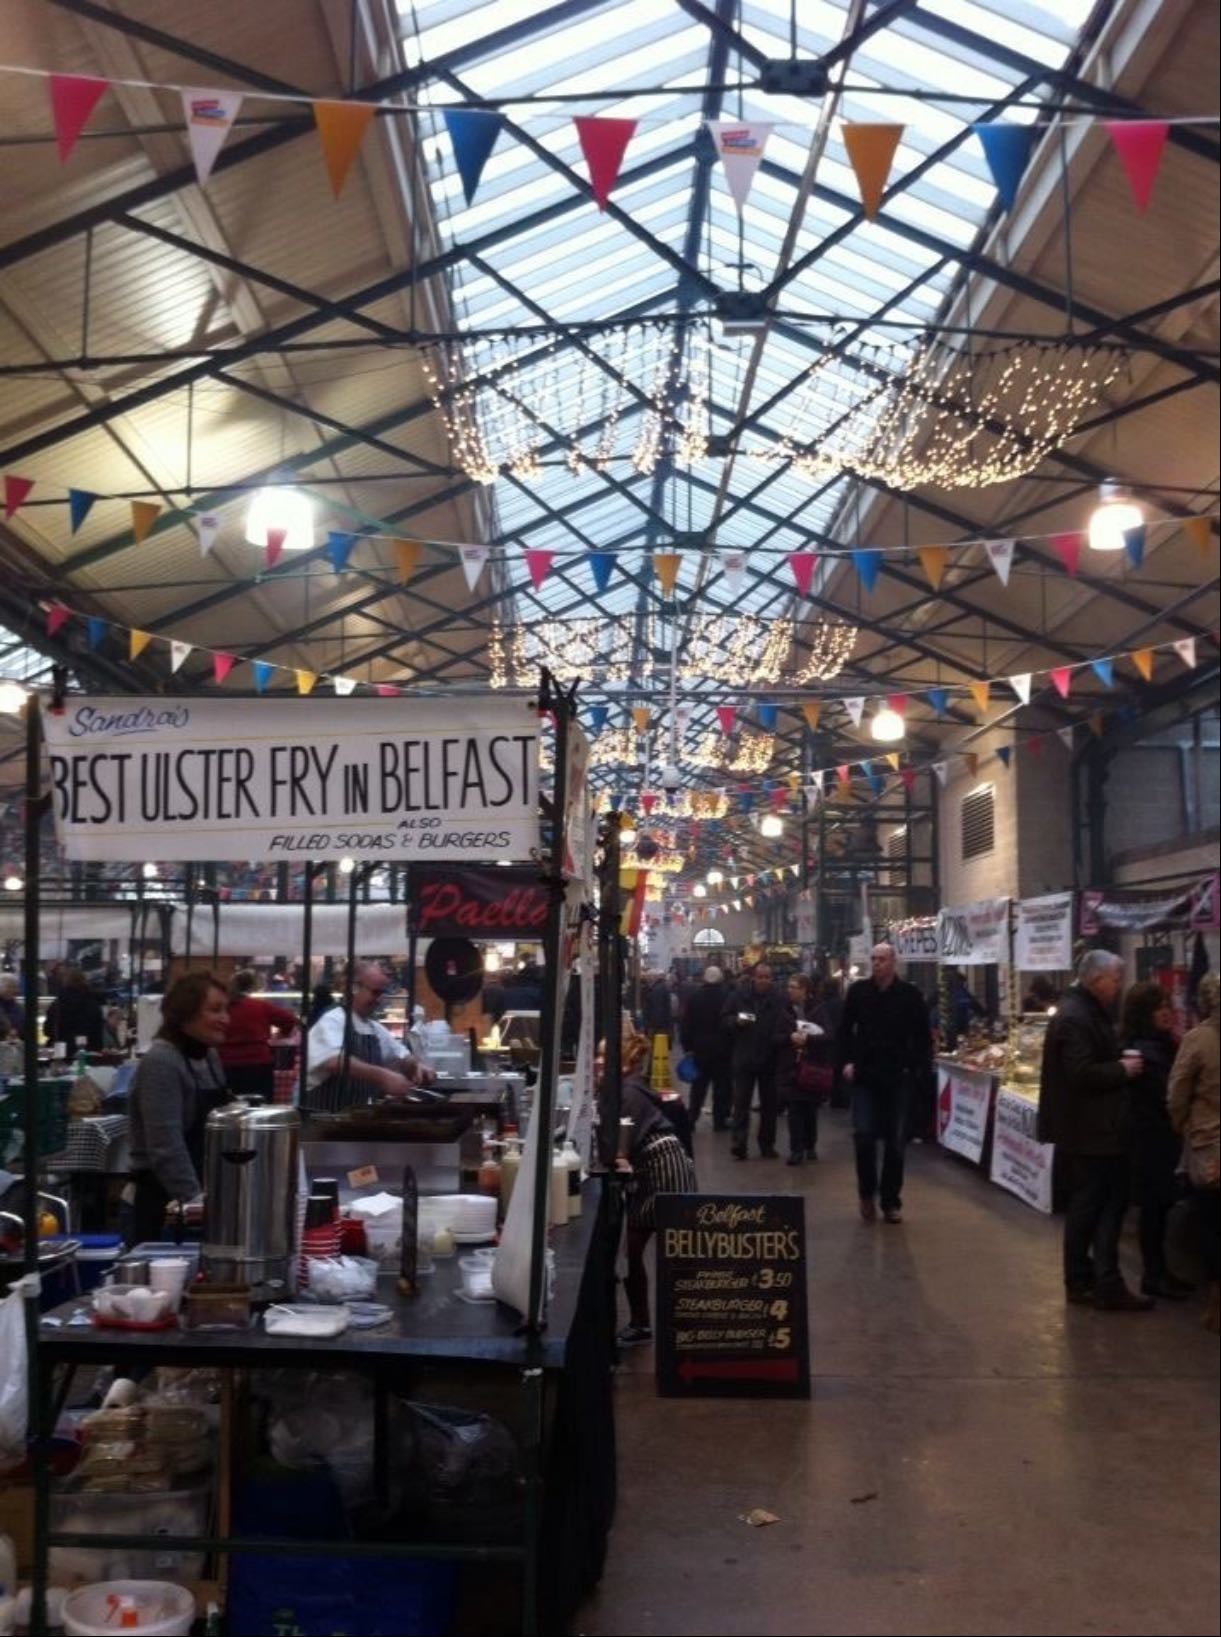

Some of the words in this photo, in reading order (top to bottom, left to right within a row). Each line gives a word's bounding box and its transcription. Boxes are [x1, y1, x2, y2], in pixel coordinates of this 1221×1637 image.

[50, 753, 132, 824] BEST
[140, 748, 260, 822] ULSTER
[270, 744, 339, 817] FRY
[344, 763, 369, 815] IN
[380, 736, 536, 814] BELFAST
[397, 817, 442, 829] ALSO
[269, 834, 330, 851] FILLED
[334, 833, 397, 849] SODAS
[418, 831, 511, 849] BURGERS
[697, 1203, 766, 1229] Belfast
